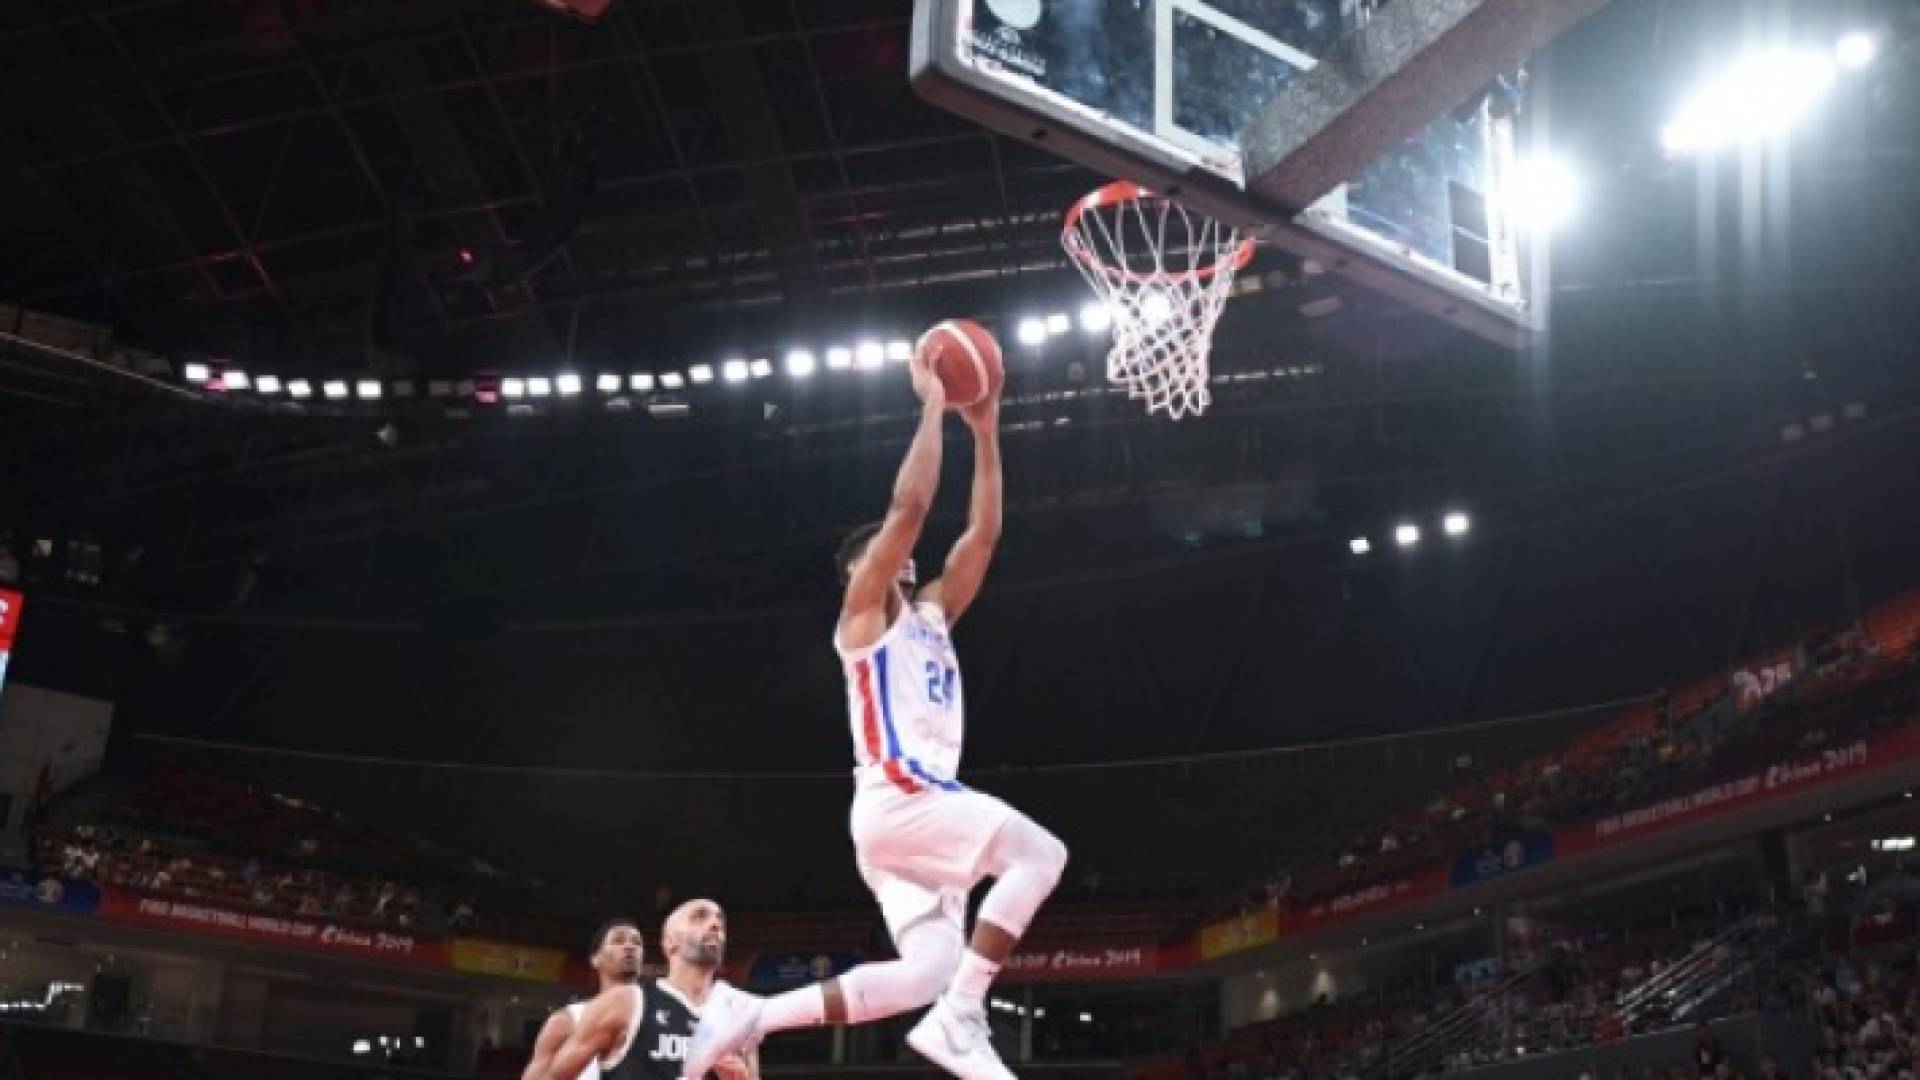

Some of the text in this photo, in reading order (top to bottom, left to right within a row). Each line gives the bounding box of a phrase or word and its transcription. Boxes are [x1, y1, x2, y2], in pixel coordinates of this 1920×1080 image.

[924, 660, 955, 709] 24
[1822, 739, 1867, 769] 2019
[375, 931, 415, 953] 2019
[1106, 947, 1140, 968] 2019
